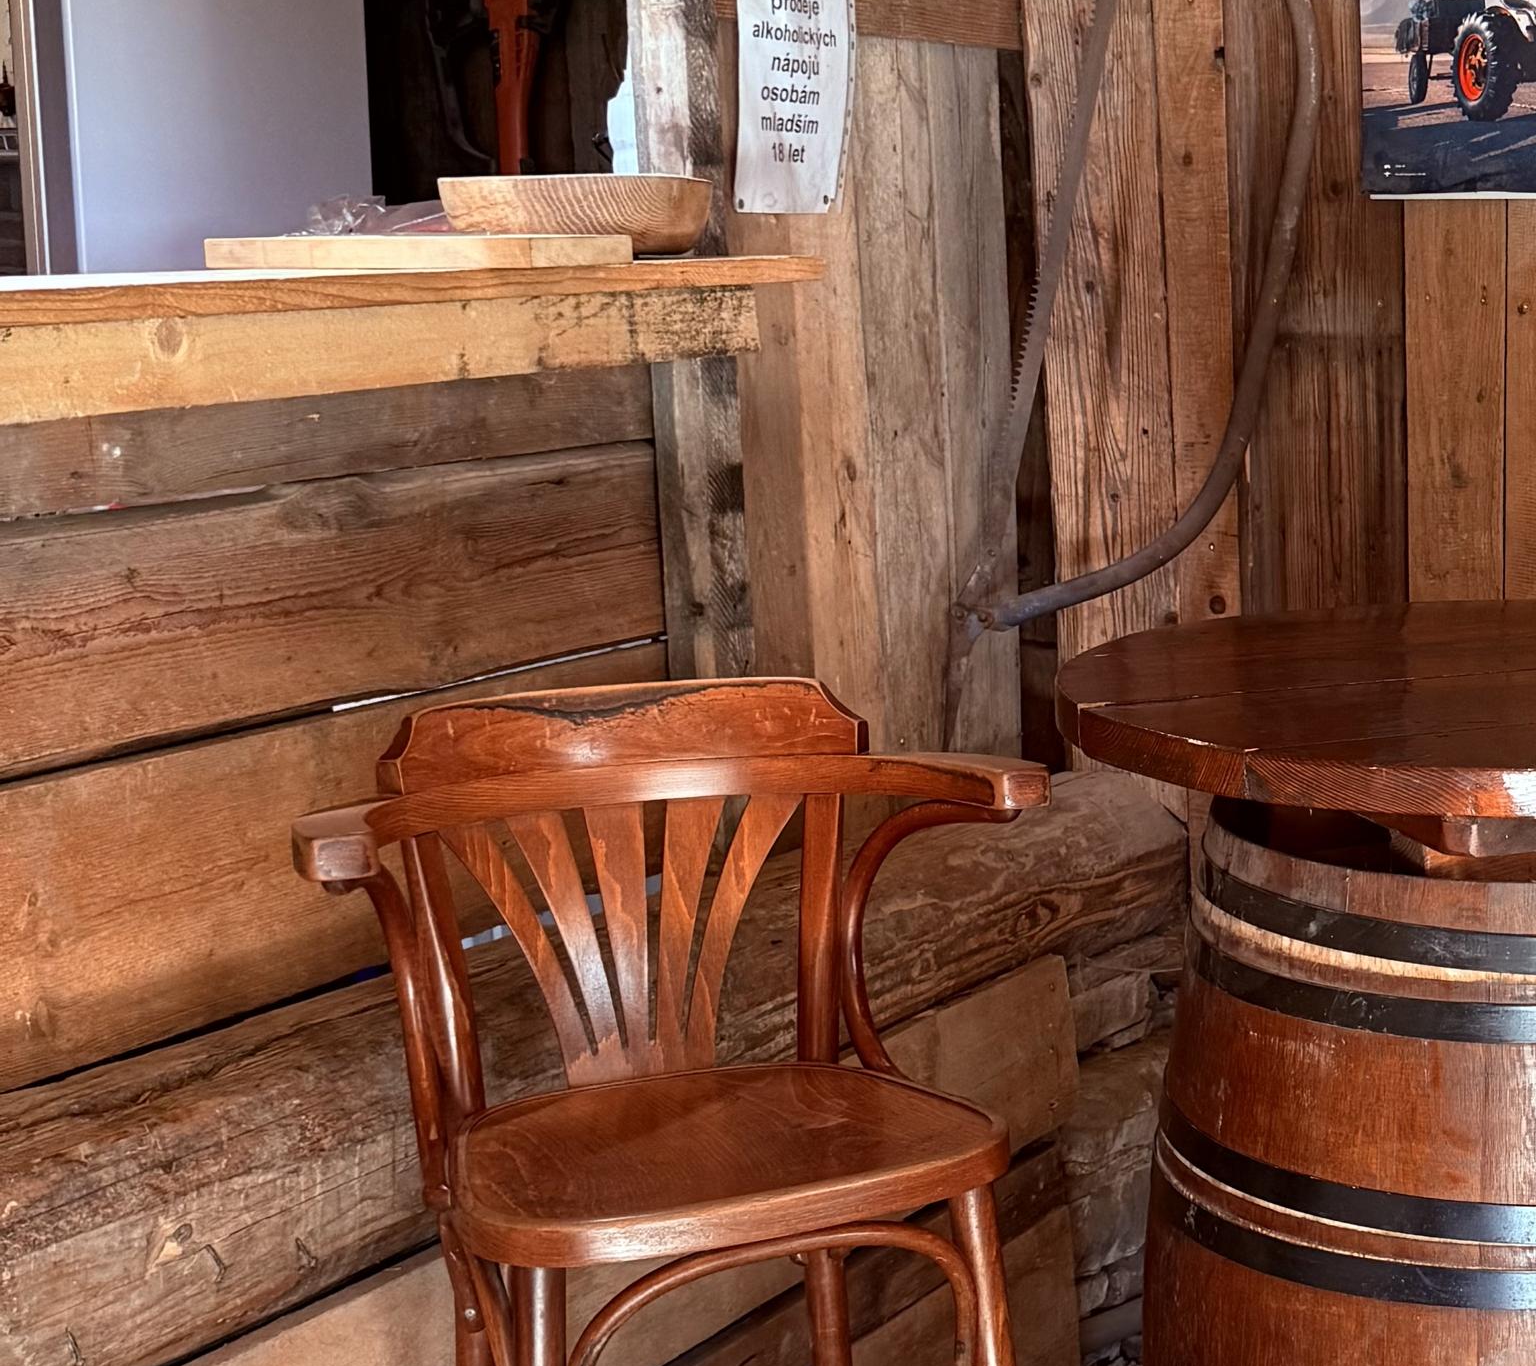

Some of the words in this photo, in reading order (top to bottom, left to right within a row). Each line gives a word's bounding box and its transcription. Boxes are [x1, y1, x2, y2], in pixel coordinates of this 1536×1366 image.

[752, 21, 837, 50] alkoholických
[771, 53, 820, 79] nápojů
[761, 85, 820, 105] osobám
[760, 114, 819, 134] mladším
[771, 143, 784, 163] 18
[788, 144, 805, 163] let
